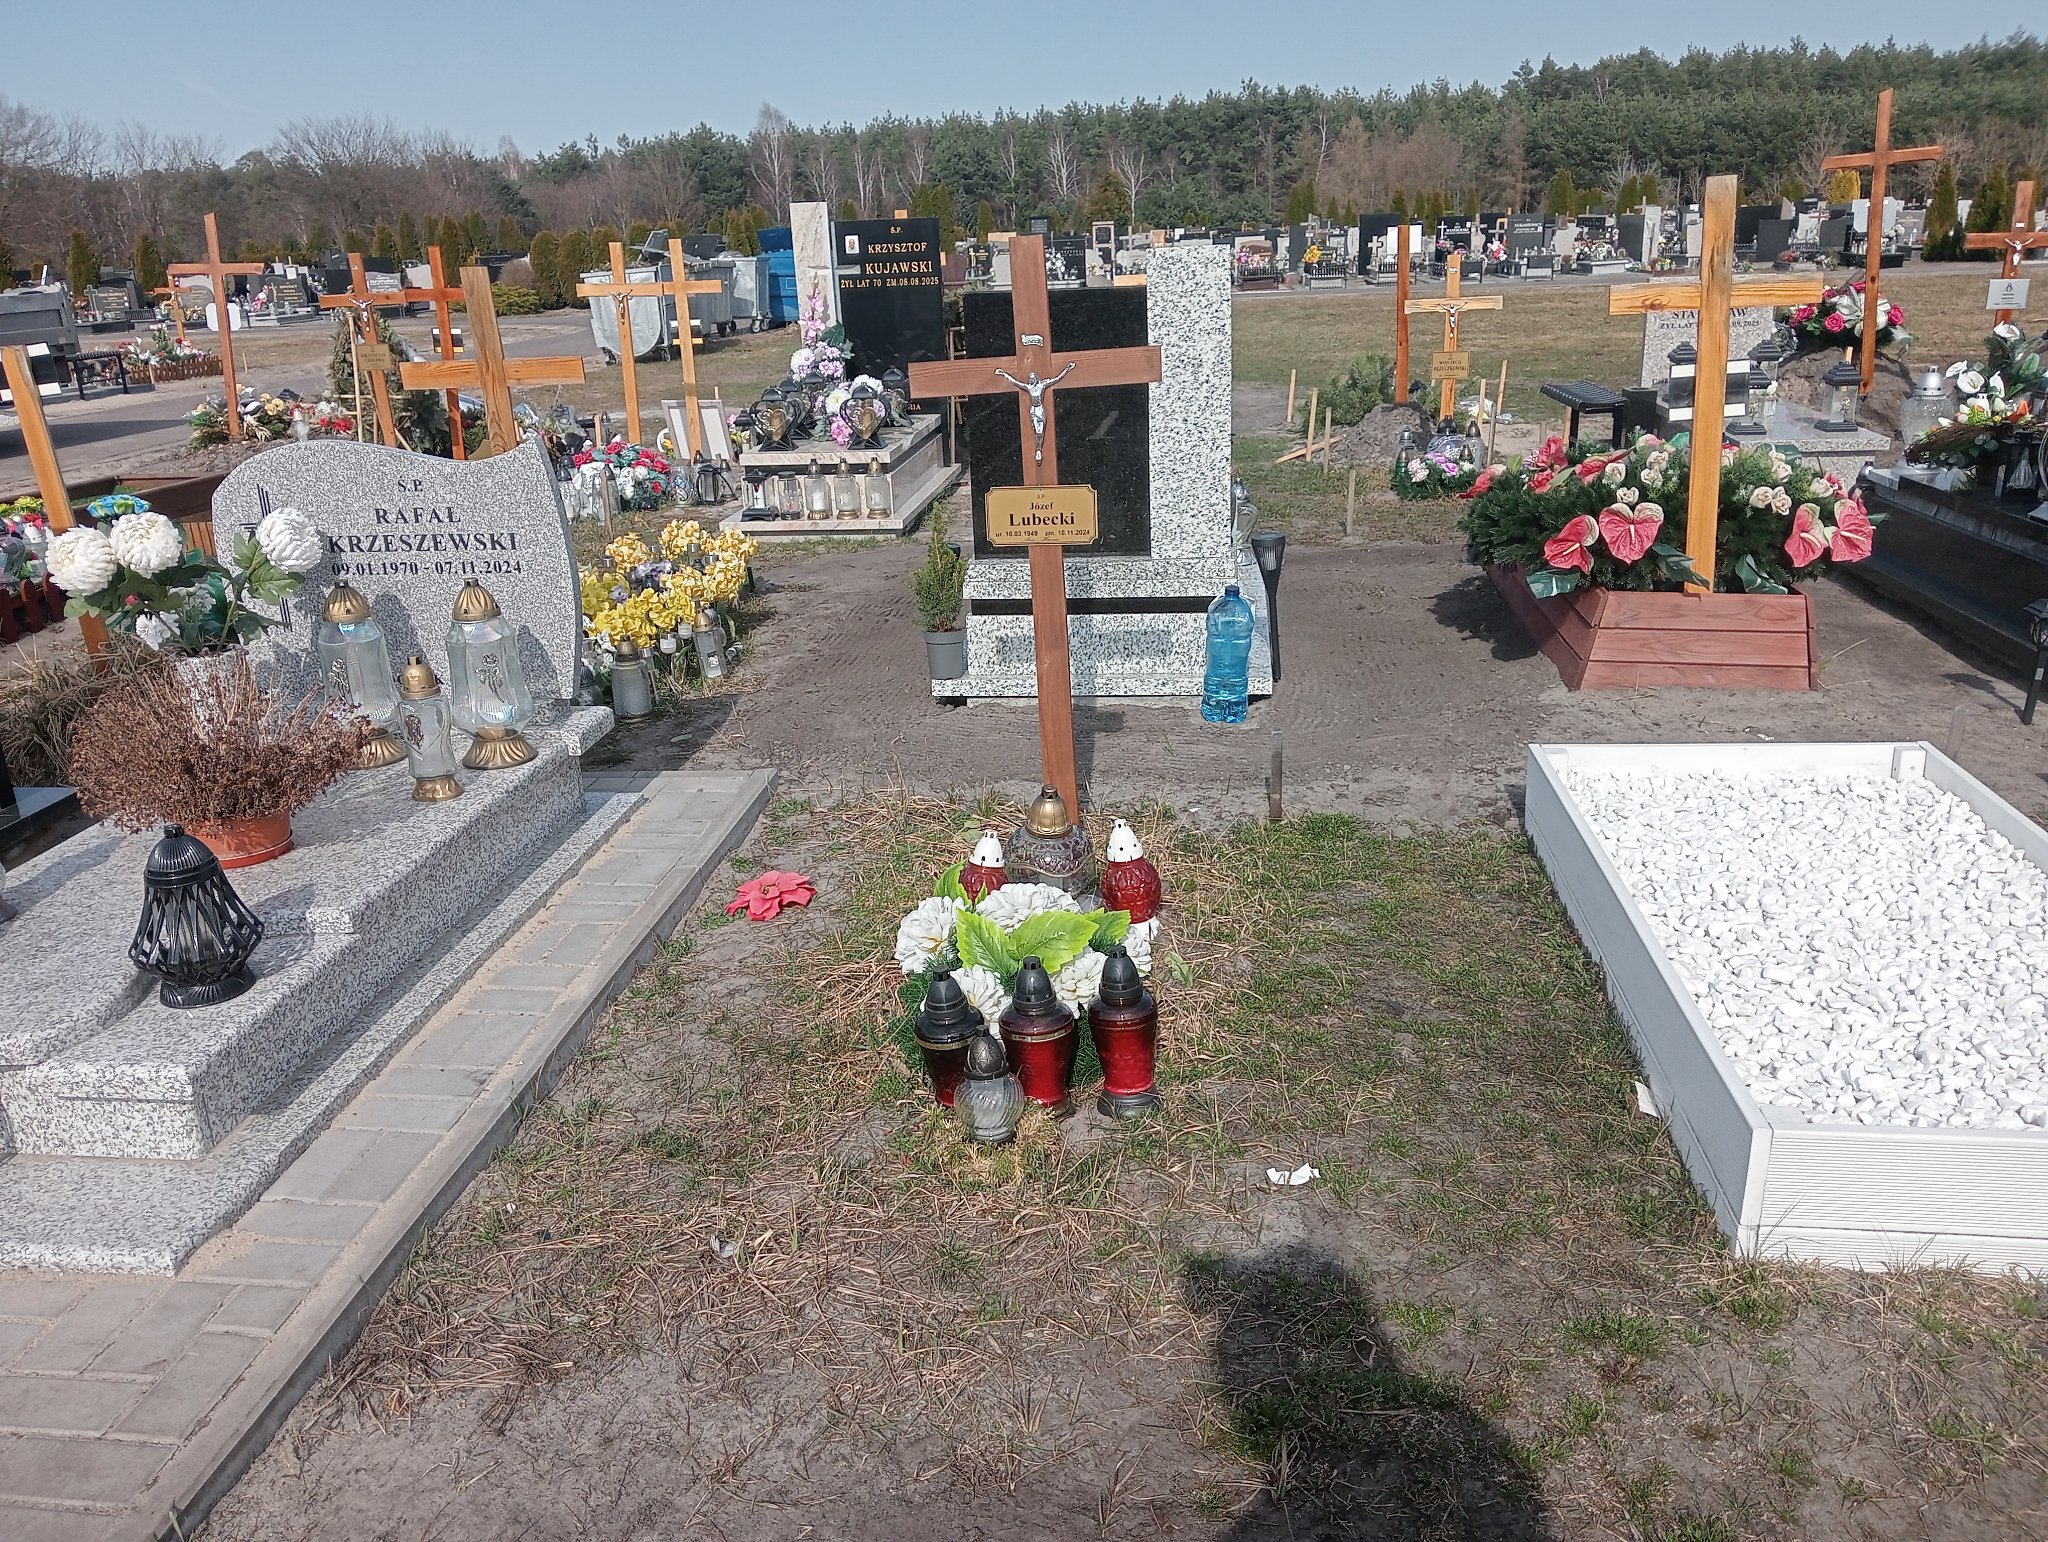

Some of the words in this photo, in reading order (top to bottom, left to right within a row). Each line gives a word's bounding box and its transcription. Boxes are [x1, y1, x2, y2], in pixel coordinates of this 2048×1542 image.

[867, 242, 928, 254] KRZYSZTOF
[865, 260, 933, 275] KUJAWSKI
[856, 279, 870, 288] LAT
[872, 278, 882, 287] 70
[1029, 501, 1055, 510] Józef
[374, 507, 461, 525] RAFAŁ
[1009, 512, 1075, 526] Lubecki
[327, 532, 517, 552] KRZESZEWSKI
[331, 561, 418, 576] 09.01.1970
[434, 560, 522, 574] 07.11.2024
